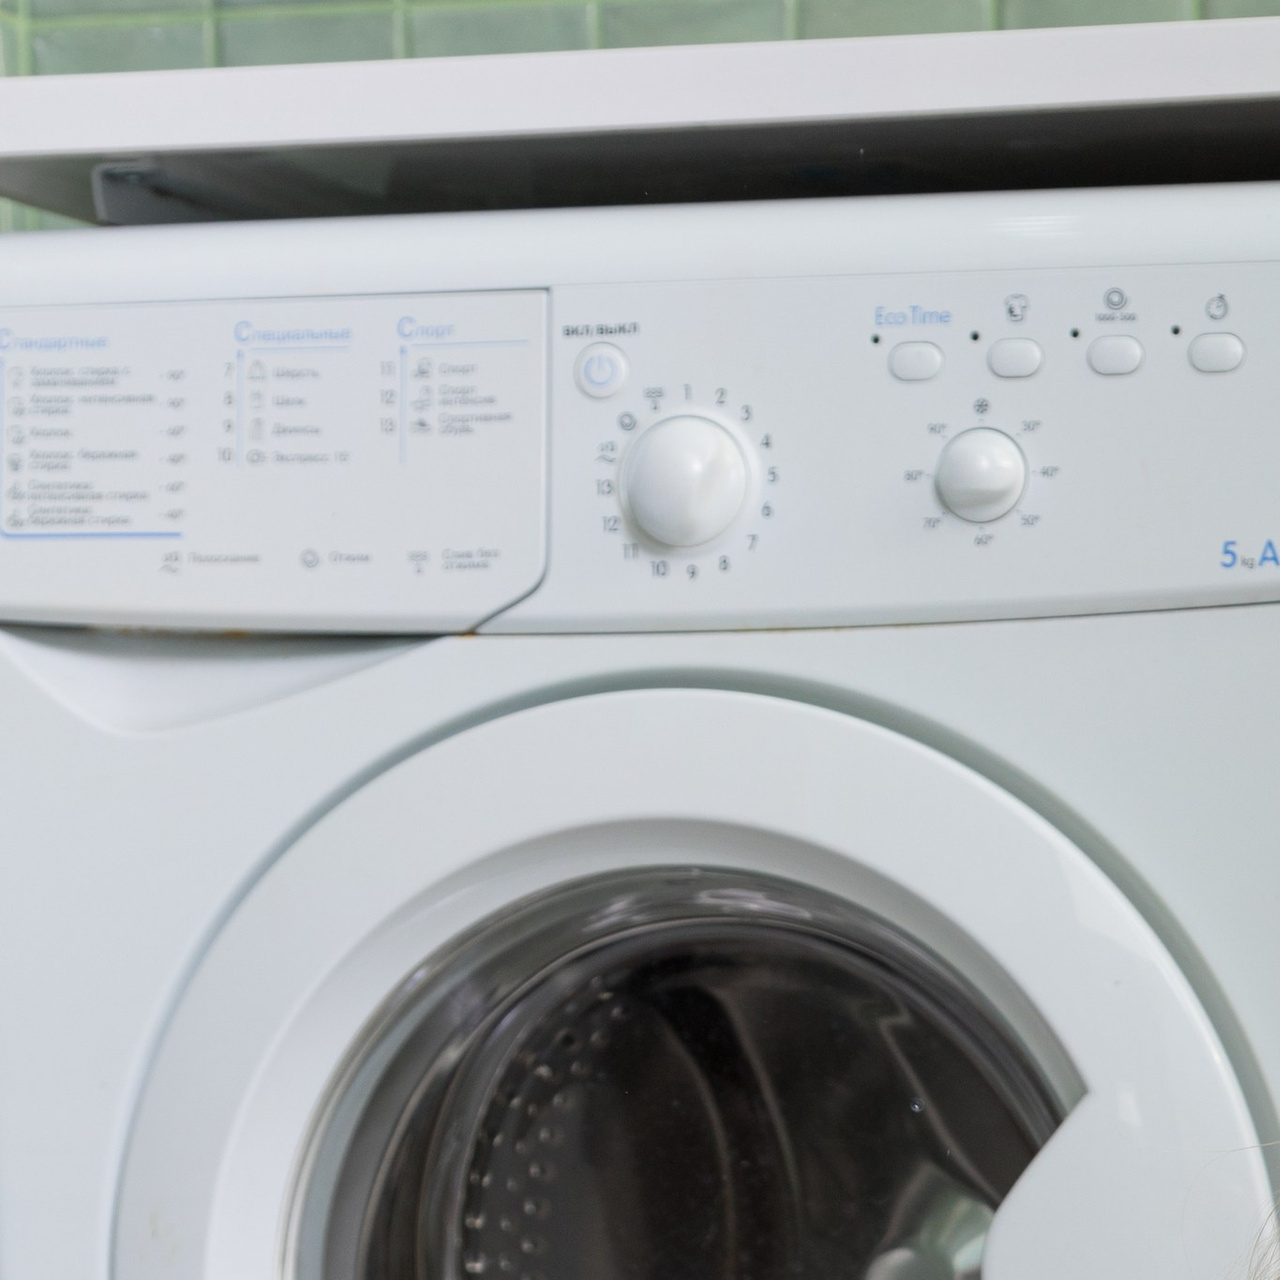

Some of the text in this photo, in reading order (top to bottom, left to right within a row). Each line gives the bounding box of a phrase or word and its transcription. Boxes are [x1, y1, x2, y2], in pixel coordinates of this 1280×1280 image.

[874, 305, 952, 326] Eco Time
[397, 315, 455, 339] Спорт
[682, 383, 693, 401] 1
[715, 388, 727, 405] 2
[740, 405, 752, 421] 3
[759, 434, 773, 450] 4
[767, 466, 780, 482] 5
[596, 478, 615, 495] 13
[761, 502, 775, 519] 6
[602, 515, 620, 532] 12
[623, 543, 640, 559] 11
[746, 534, 760, 551] 7
[1220, 540, 1238, 568] 5
[1241, 554, 1256, 570] kg
[1257, 538, 1280, 567] A
[650, 560, 670, 577] 10
[686, 564, 699, 580] 9
[718, 555, 732, 573] 8
